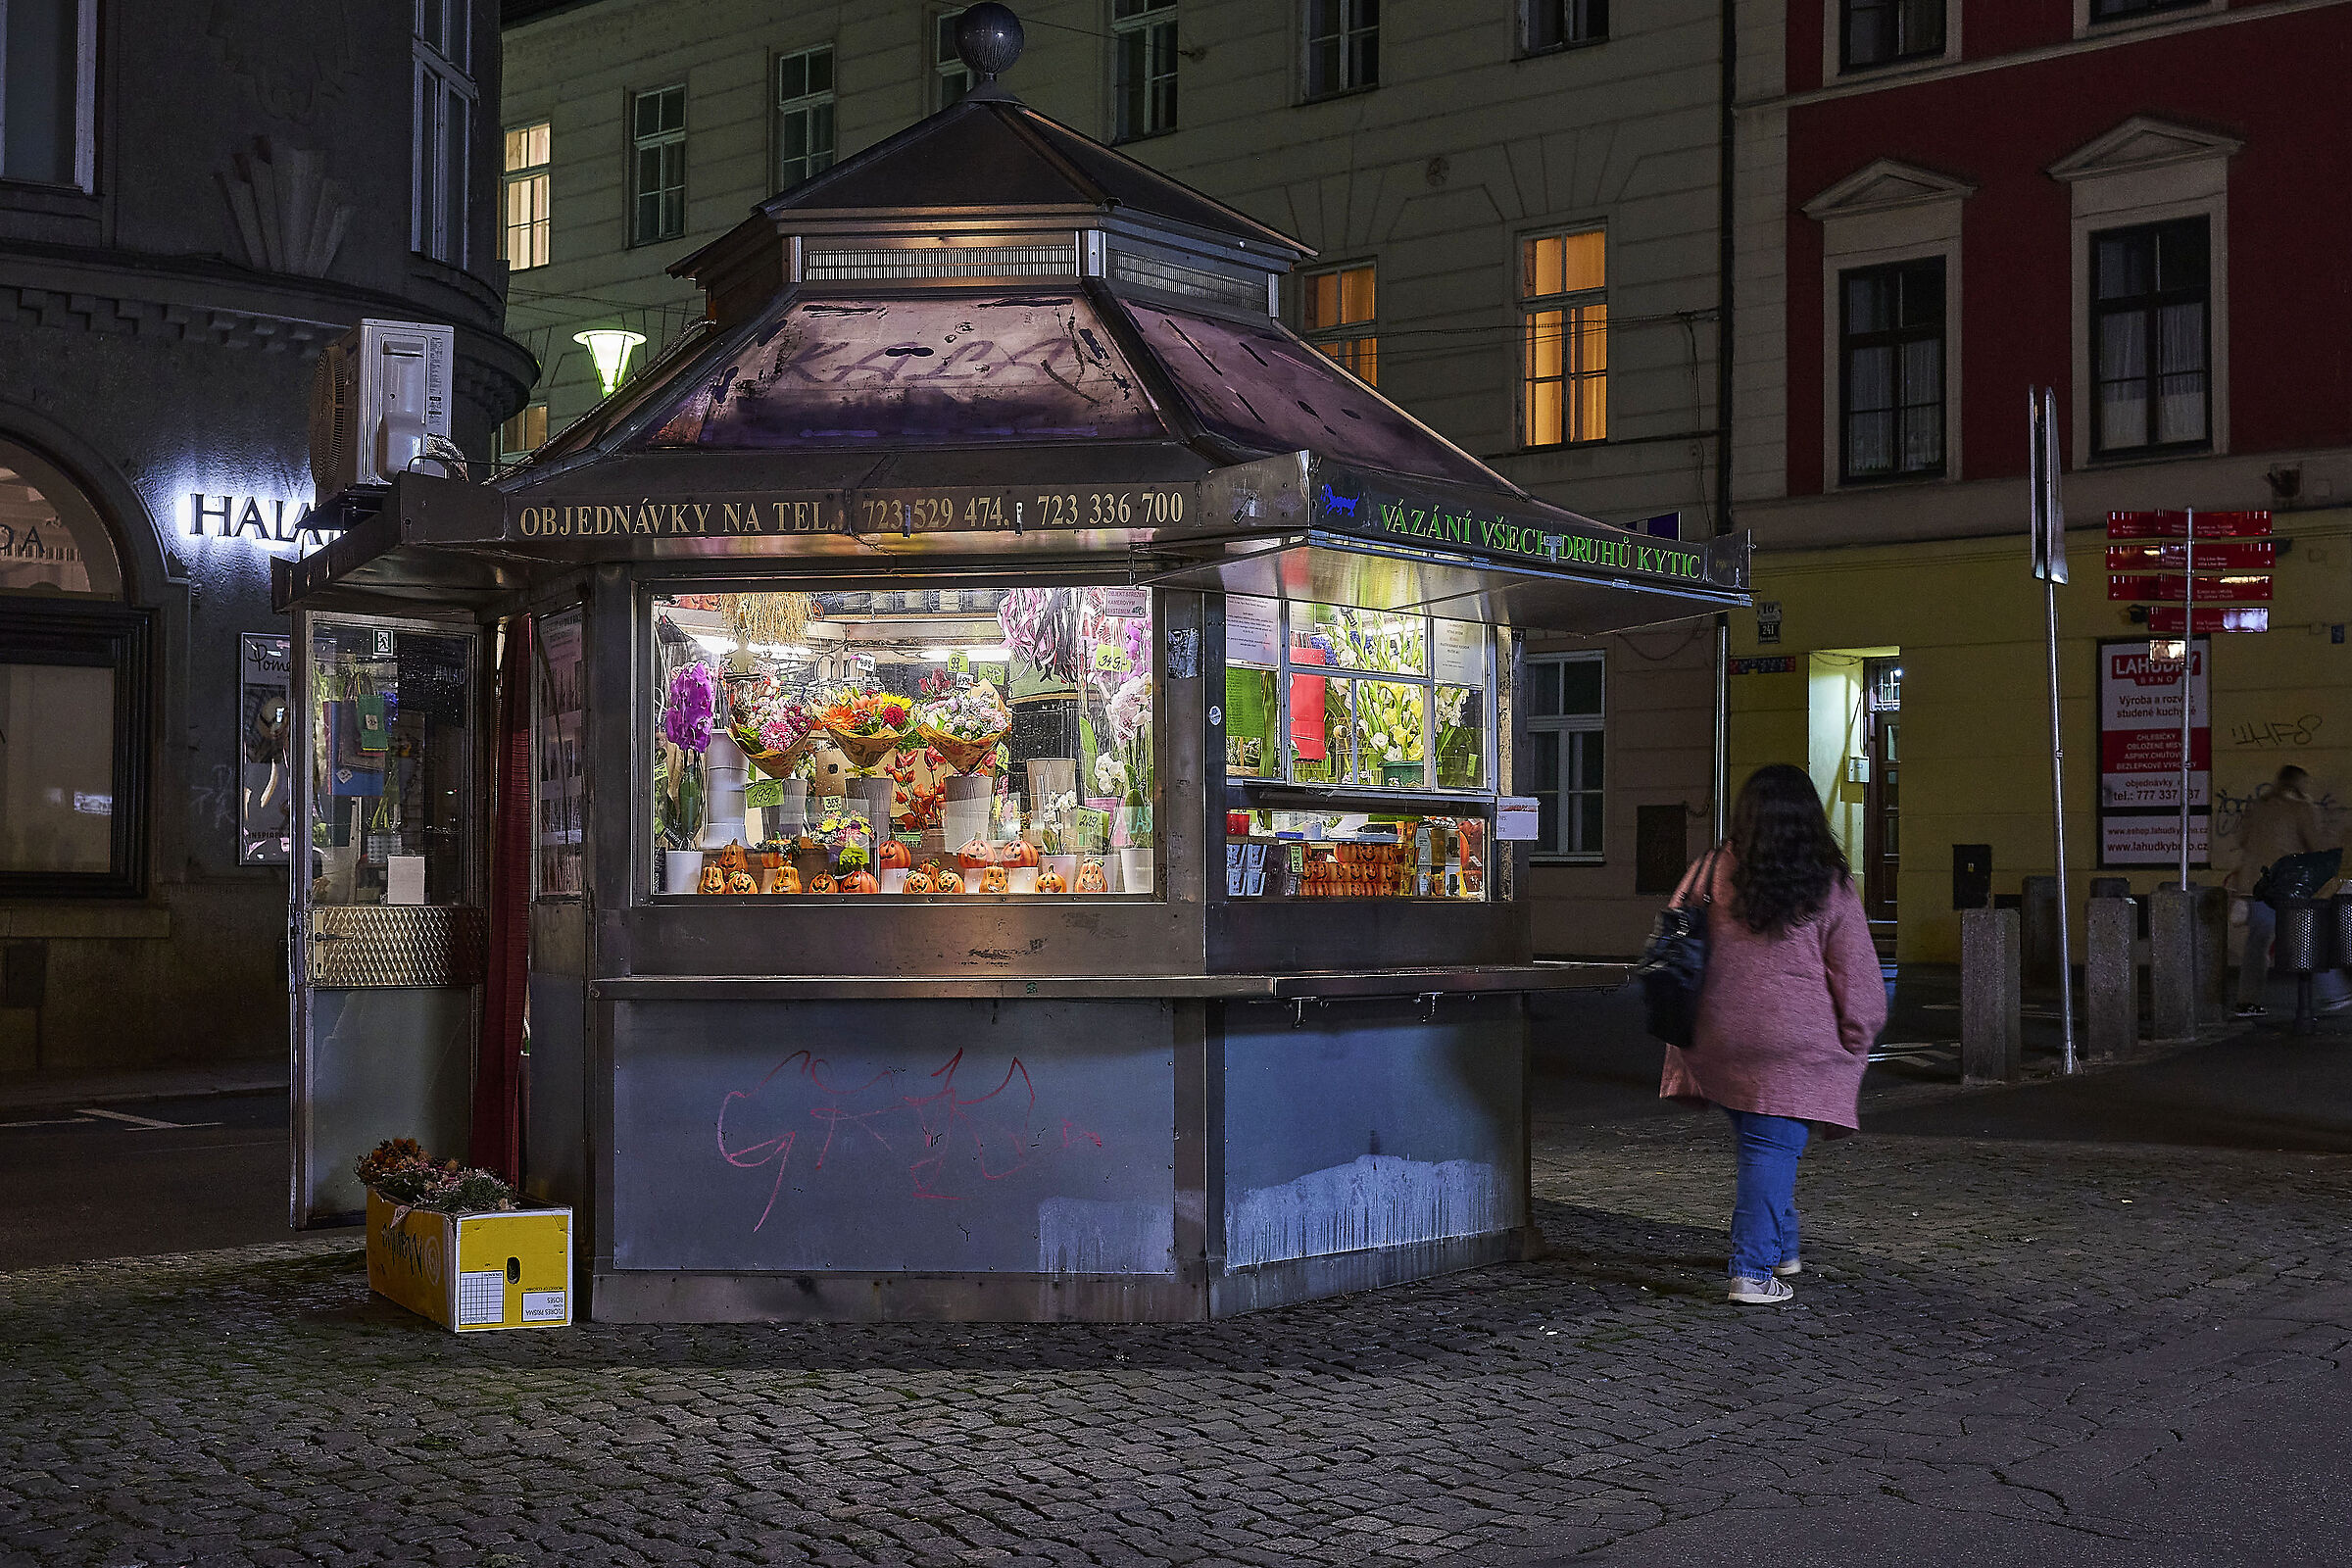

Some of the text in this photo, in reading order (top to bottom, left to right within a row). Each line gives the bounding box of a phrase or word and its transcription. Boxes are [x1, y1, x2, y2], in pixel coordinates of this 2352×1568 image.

[190, 493, 337, 547] HALA
[519, 497, 711, 537] OBJEDNÁVKY
[722, 503, 762, 533] NA
[862, 499, 903, 531] 723
[913, 497, 955, 528] 529
[963, 496, 1010, 529] 474,
[1036, 494, 1078, 526] 723
[1089, 492, 1131, 524] 336
[1141, 491, 1185, 523] 700
[1378, 498, 1701, 580] VÁZÁNÍ VŠECH DRUHŮ KYTIC
[248, 642, 292, 672] Pome
